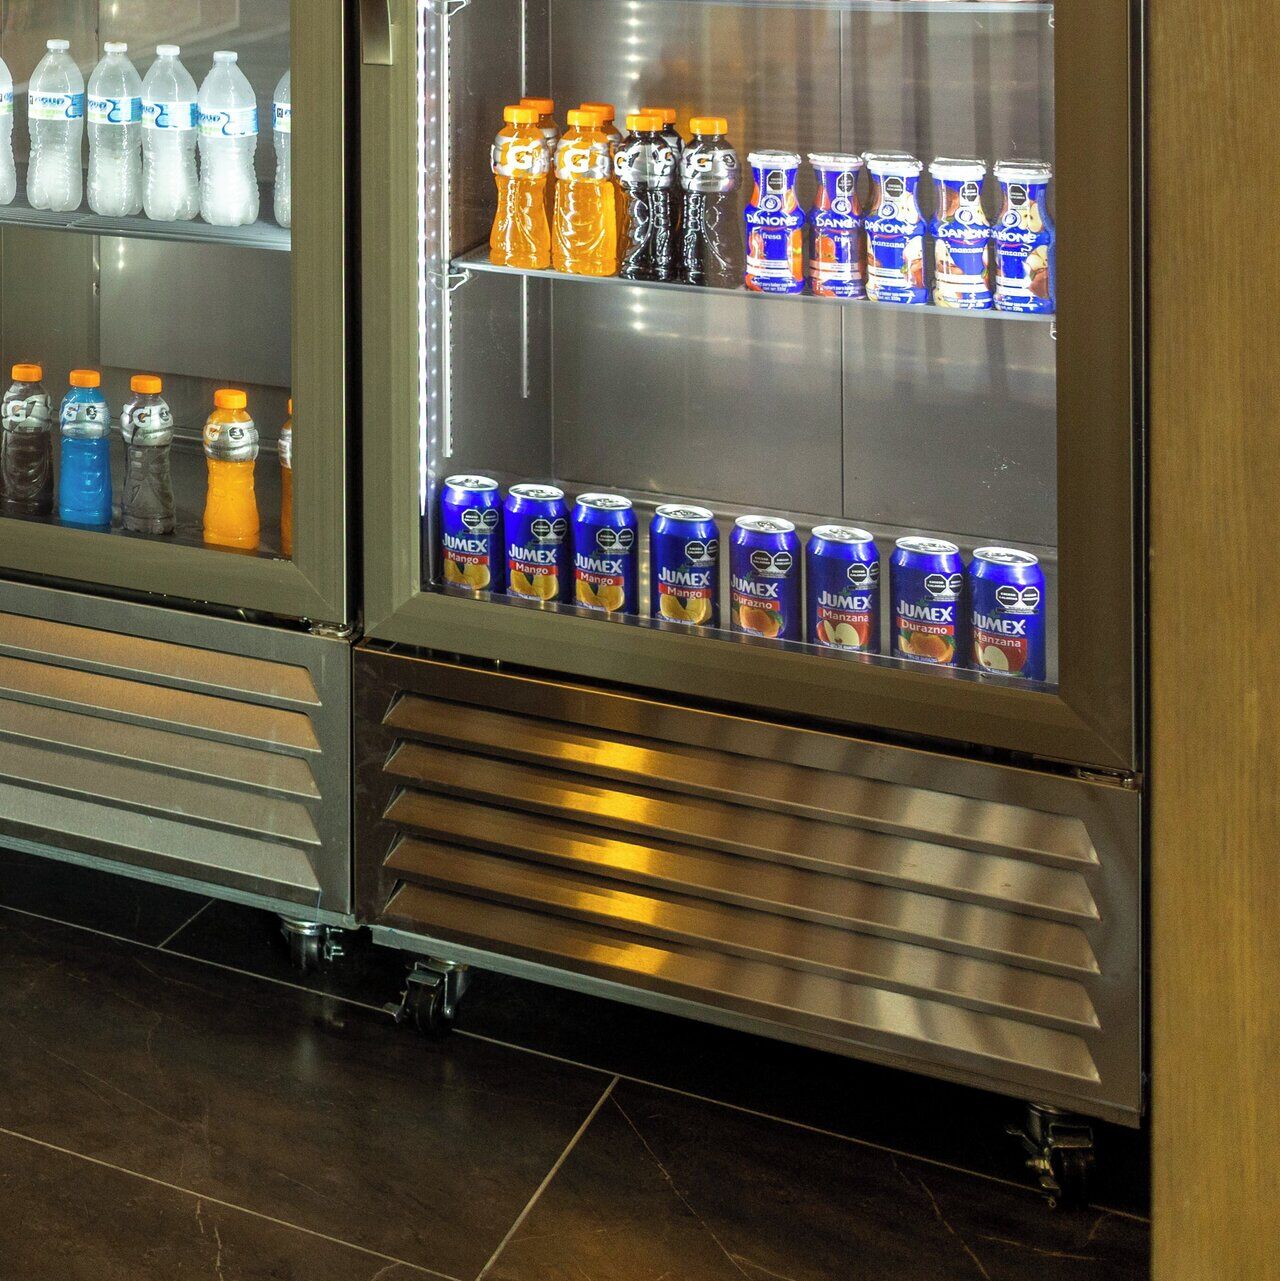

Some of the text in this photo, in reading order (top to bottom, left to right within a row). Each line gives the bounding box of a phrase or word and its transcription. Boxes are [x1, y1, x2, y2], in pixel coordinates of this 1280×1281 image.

[746, 213, 798, 226] DANONE
[8, 400, 28, 423] G
[442, 533, 488, 553] JUMEX
[447, 551, 479, 565] Mango
[508, 544, 557, 564] JUMEX
[575, 552, 623, 574] JUMEX
[515, 562, 549, 576] Mango
[580, 571, 614, 586] Mango
[658, 566, 710, 586] JUMEX
[667, 586, 703, 601] Mango
[731, 573, 779, 598] JUMEX
[734, 592, 773, 610] Durazno
[817, 590, 872, 610] JUMEX
[822, 610, 870, 623] Manzana
[896, 599, 954, 622] JUMEX
[901, 619, 948, 634] Durazno
[971, 612, 1027, 635] JUMEX
[973, 631, 1022, 648] Manzana
